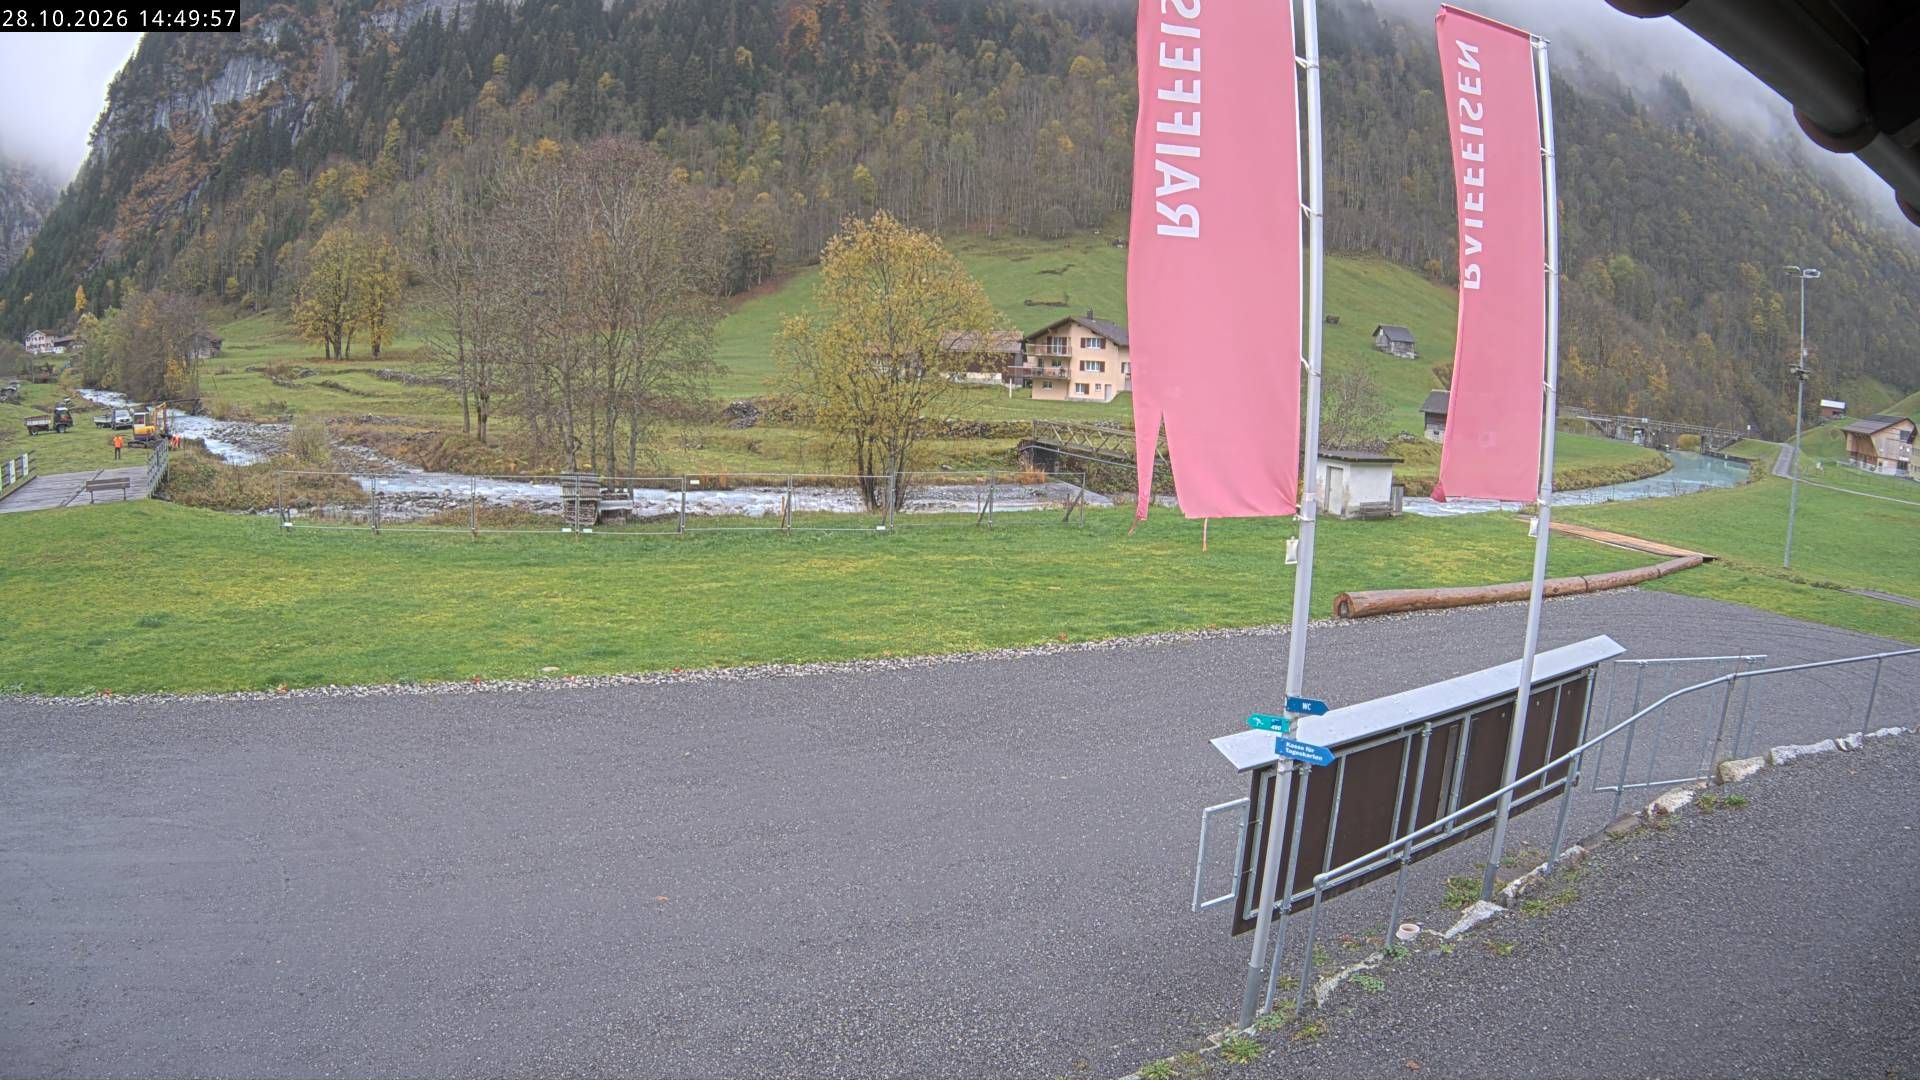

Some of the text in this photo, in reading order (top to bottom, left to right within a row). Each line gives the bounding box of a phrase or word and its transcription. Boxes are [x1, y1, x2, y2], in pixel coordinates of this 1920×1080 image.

[1302, 702, 1312, 710] WC
[1286, 742, 1315, 753] Kasse für
[1286, 747, 1323, 760] Tageskarten
